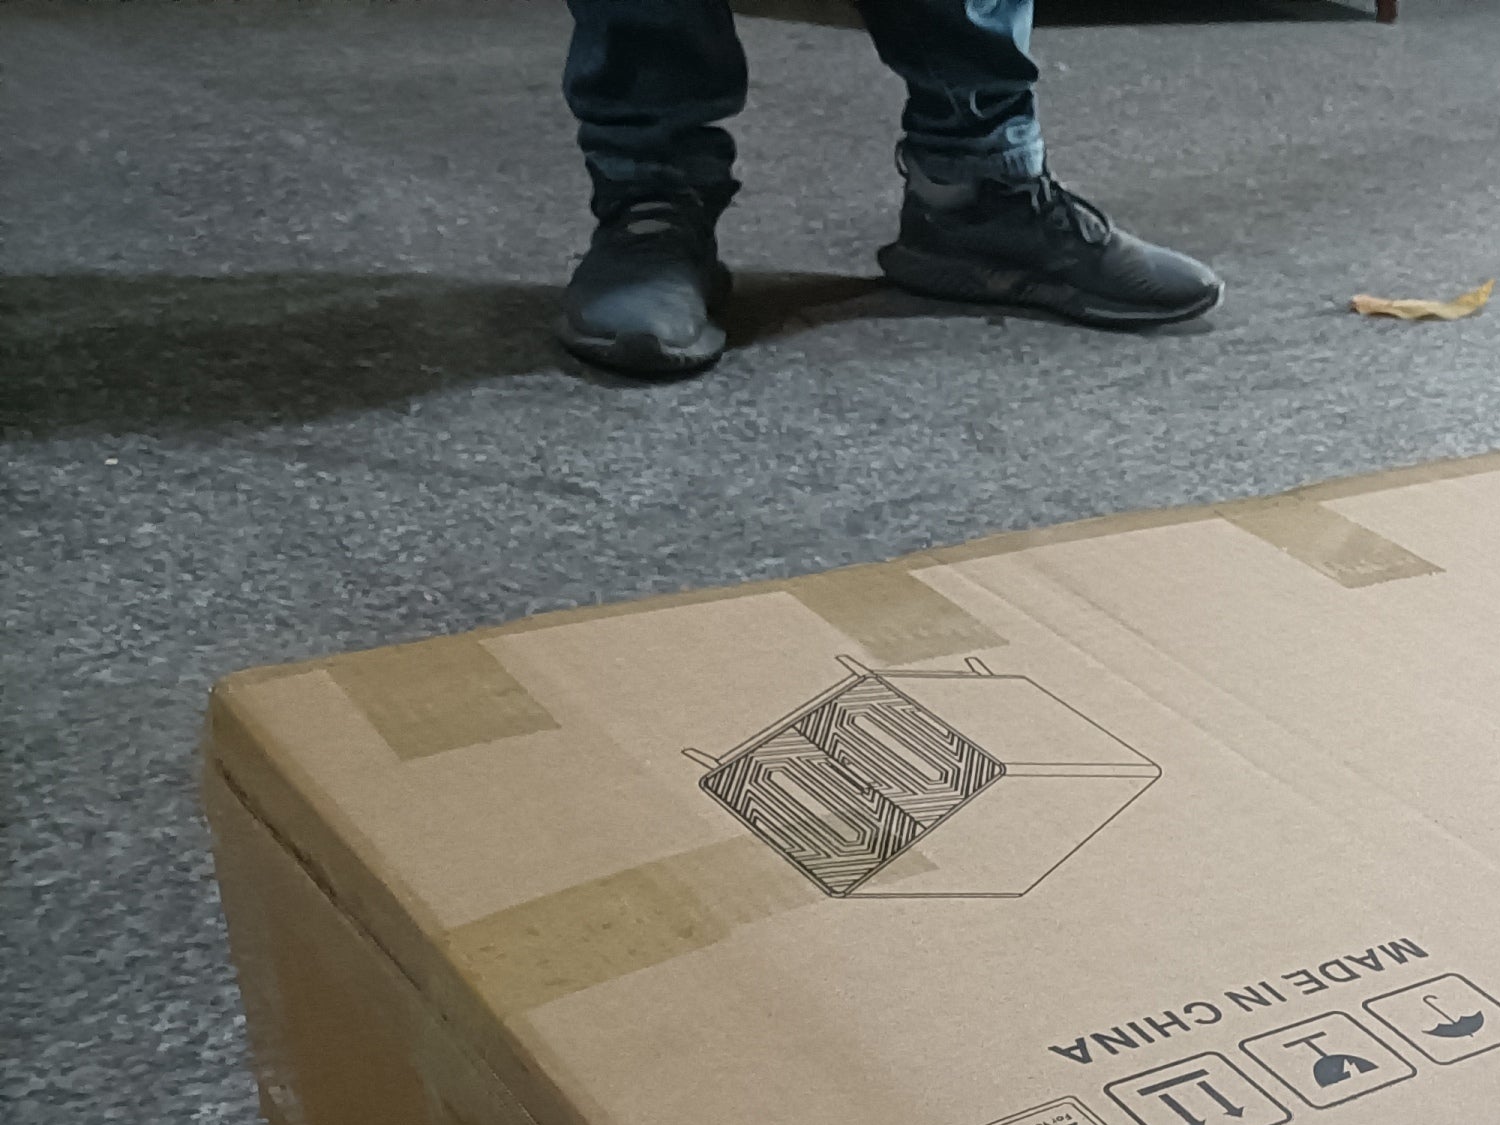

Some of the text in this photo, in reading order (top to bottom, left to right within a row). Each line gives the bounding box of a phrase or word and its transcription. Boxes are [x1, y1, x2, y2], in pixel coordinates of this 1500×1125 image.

[1048, 938, 1429, 1065] MADE IN CHINA
[1052, 1113, 1073, 1124] For
